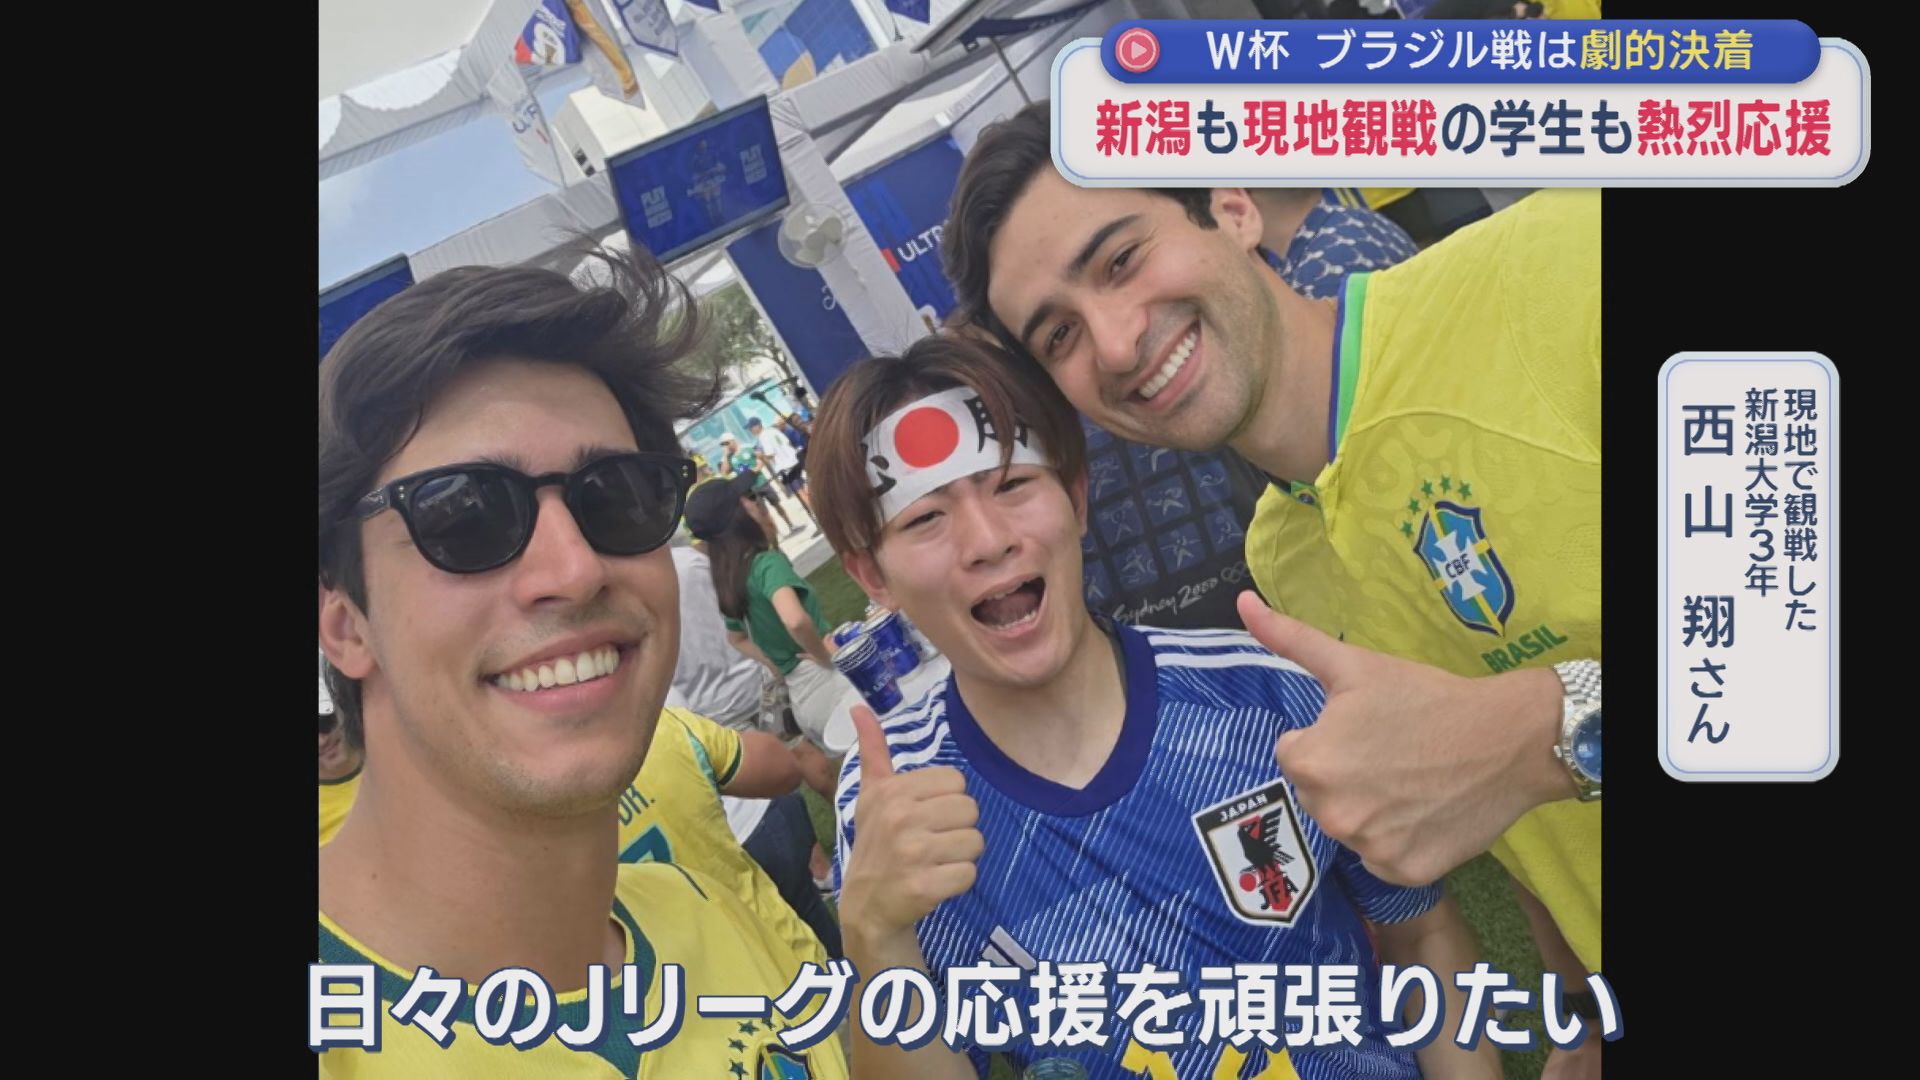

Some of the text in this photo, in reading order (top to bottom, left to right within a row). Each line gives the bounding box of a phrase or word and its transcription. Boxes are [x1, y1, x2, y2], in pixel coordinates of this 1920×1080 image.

[897, 220, 949, 262] ULTR
[1445, 553, 1471, 578] CBF
[1112, 577, 1219, 625] Sydney 2000
[1480, 623, 1569, 674] BRASIL
[1219, 792, 1268, 823] JAPAN
